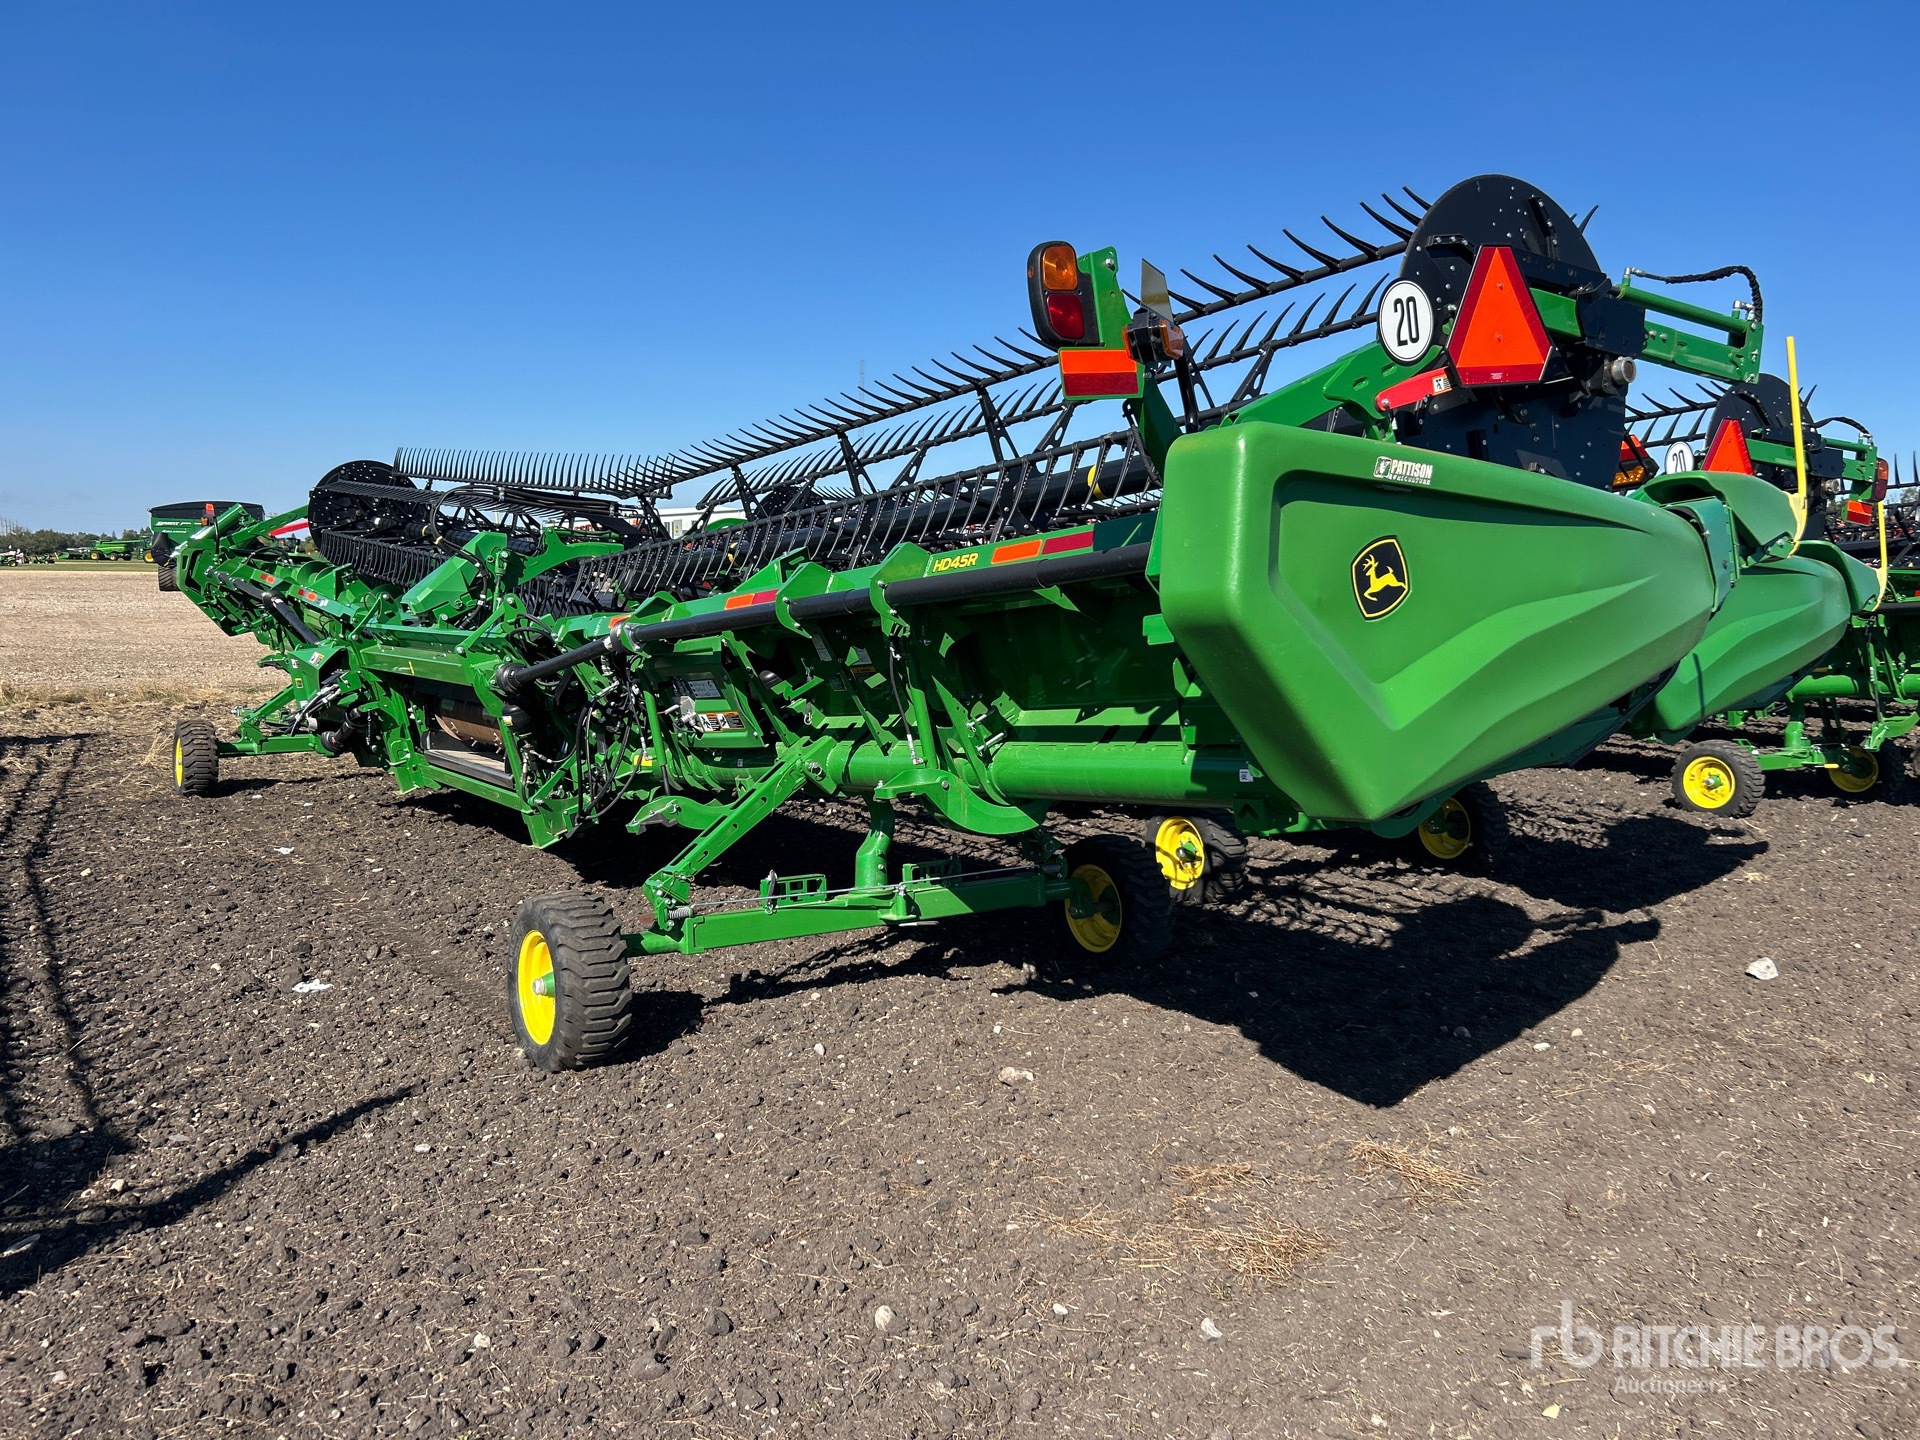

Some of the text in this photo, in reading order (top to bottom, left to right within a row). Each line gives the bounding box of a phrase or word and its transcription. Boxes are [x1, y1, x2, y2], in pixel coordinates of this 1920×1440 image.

[1394, 296, 1419, 346] 20
[1390, 459, 1433, 479] PATTISON
[932, 552, 978, 573] HD45R
